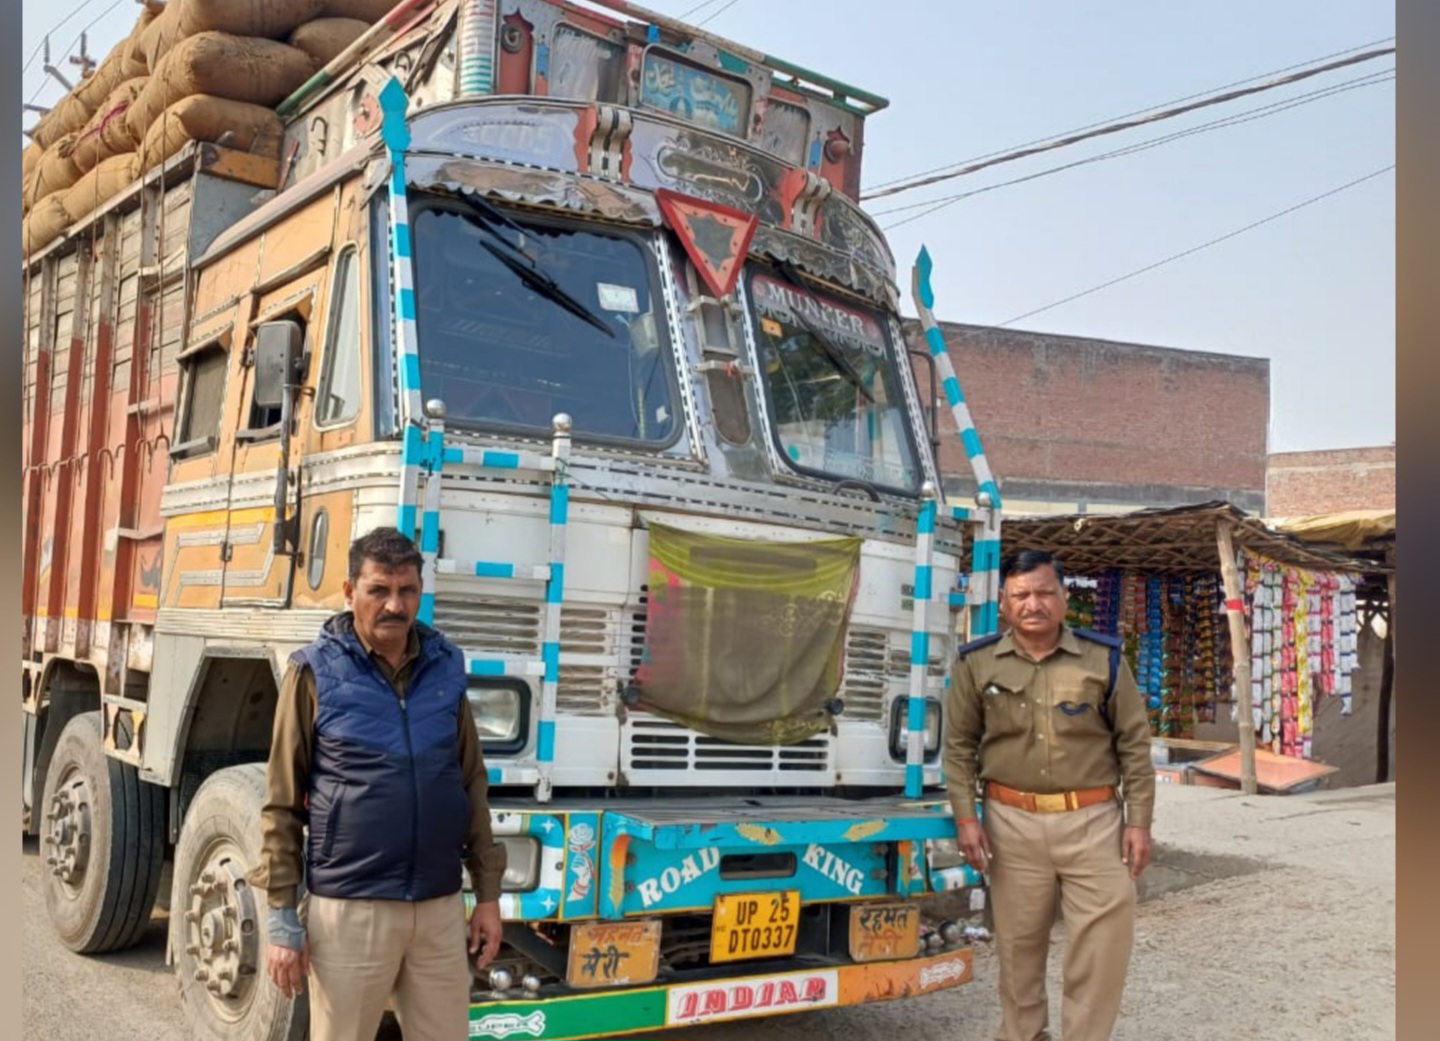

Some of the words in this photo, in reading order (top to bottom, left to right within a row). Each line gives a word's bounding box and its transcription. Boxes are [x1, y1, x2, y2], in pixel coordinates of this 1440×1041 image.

[637, 846, 721, 908] ROAD
[801, 843, 865, 895] KING
[736, 900, 759, 926] UP
[768, 898, 790, 923] 25
[859, 905, 917, 937] रहमत
[728, 924, 795, 954] DT0337
[676, 976, 827, 1020] INDIAN
